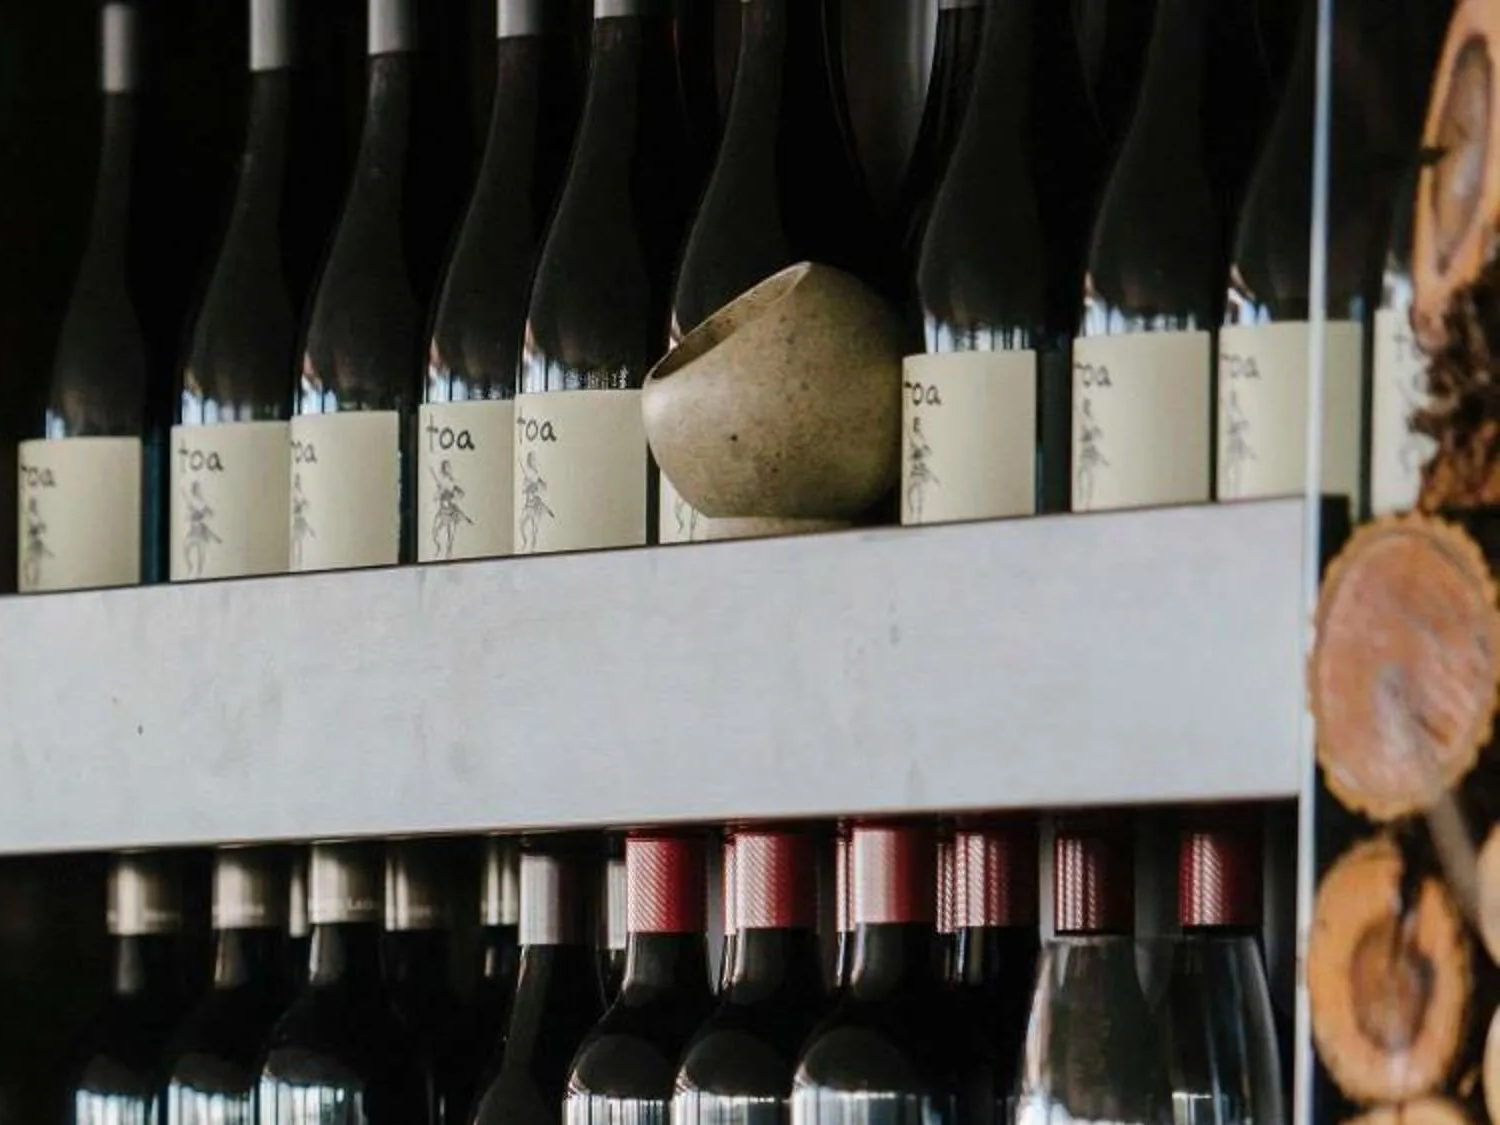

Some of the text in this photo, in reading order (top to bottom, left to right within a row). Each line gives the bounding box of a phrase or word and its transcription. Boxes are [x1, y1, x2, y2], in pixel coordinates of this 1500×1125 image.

[904, 366, 941, 408] toa
[426, 413, 475, 451] toa
[517, 406, 557, 445] toa
[178, 440, 224, 472] toa
